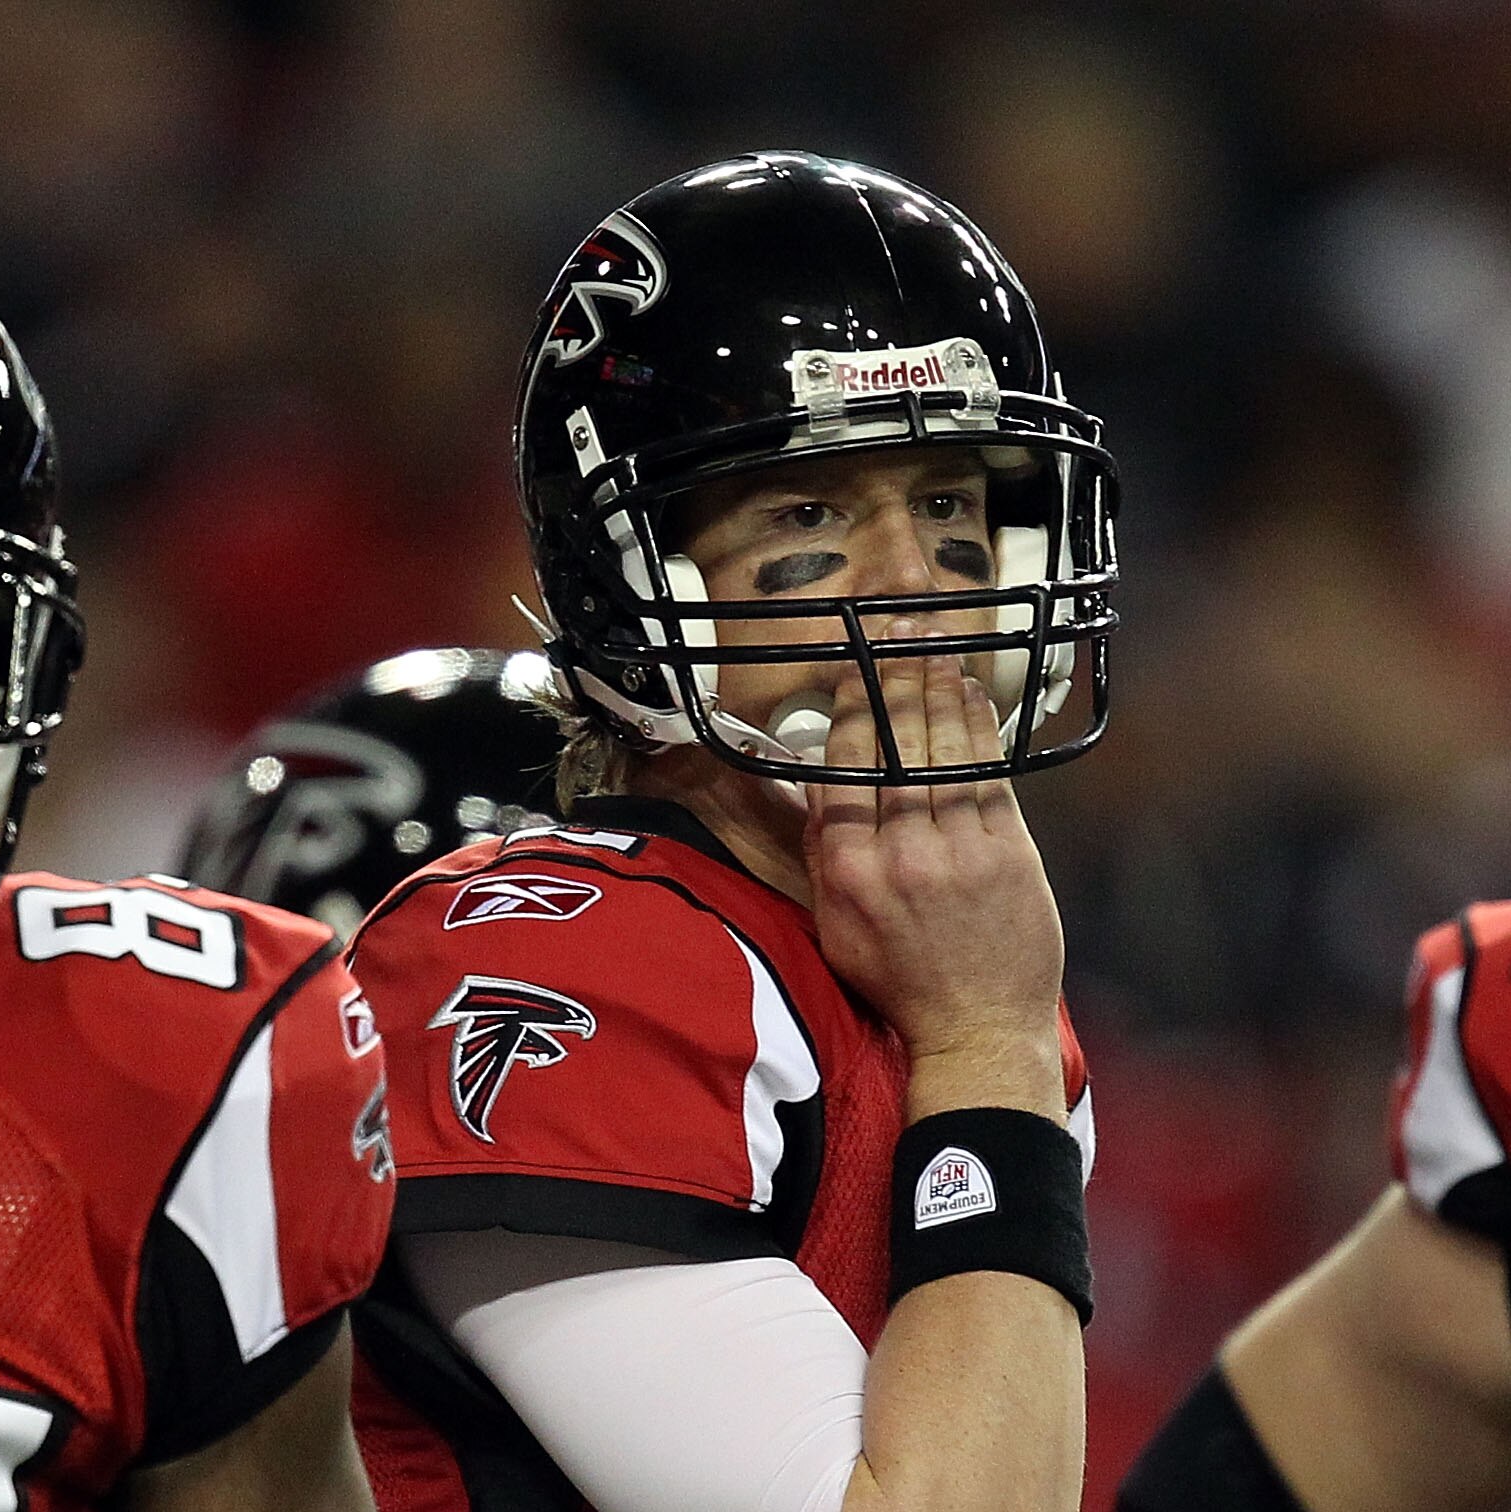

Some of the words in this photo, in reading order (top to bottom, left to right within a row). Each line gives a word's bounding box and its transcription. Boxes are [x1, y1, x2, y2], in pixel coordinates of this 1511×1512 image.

[835, 356, 945, 392] Riddell
[15, 872, 243, 988] 8
[935, 1164, 965, 1184] NFL
[919, 1192, 986, 1217] EQUIPMENT
